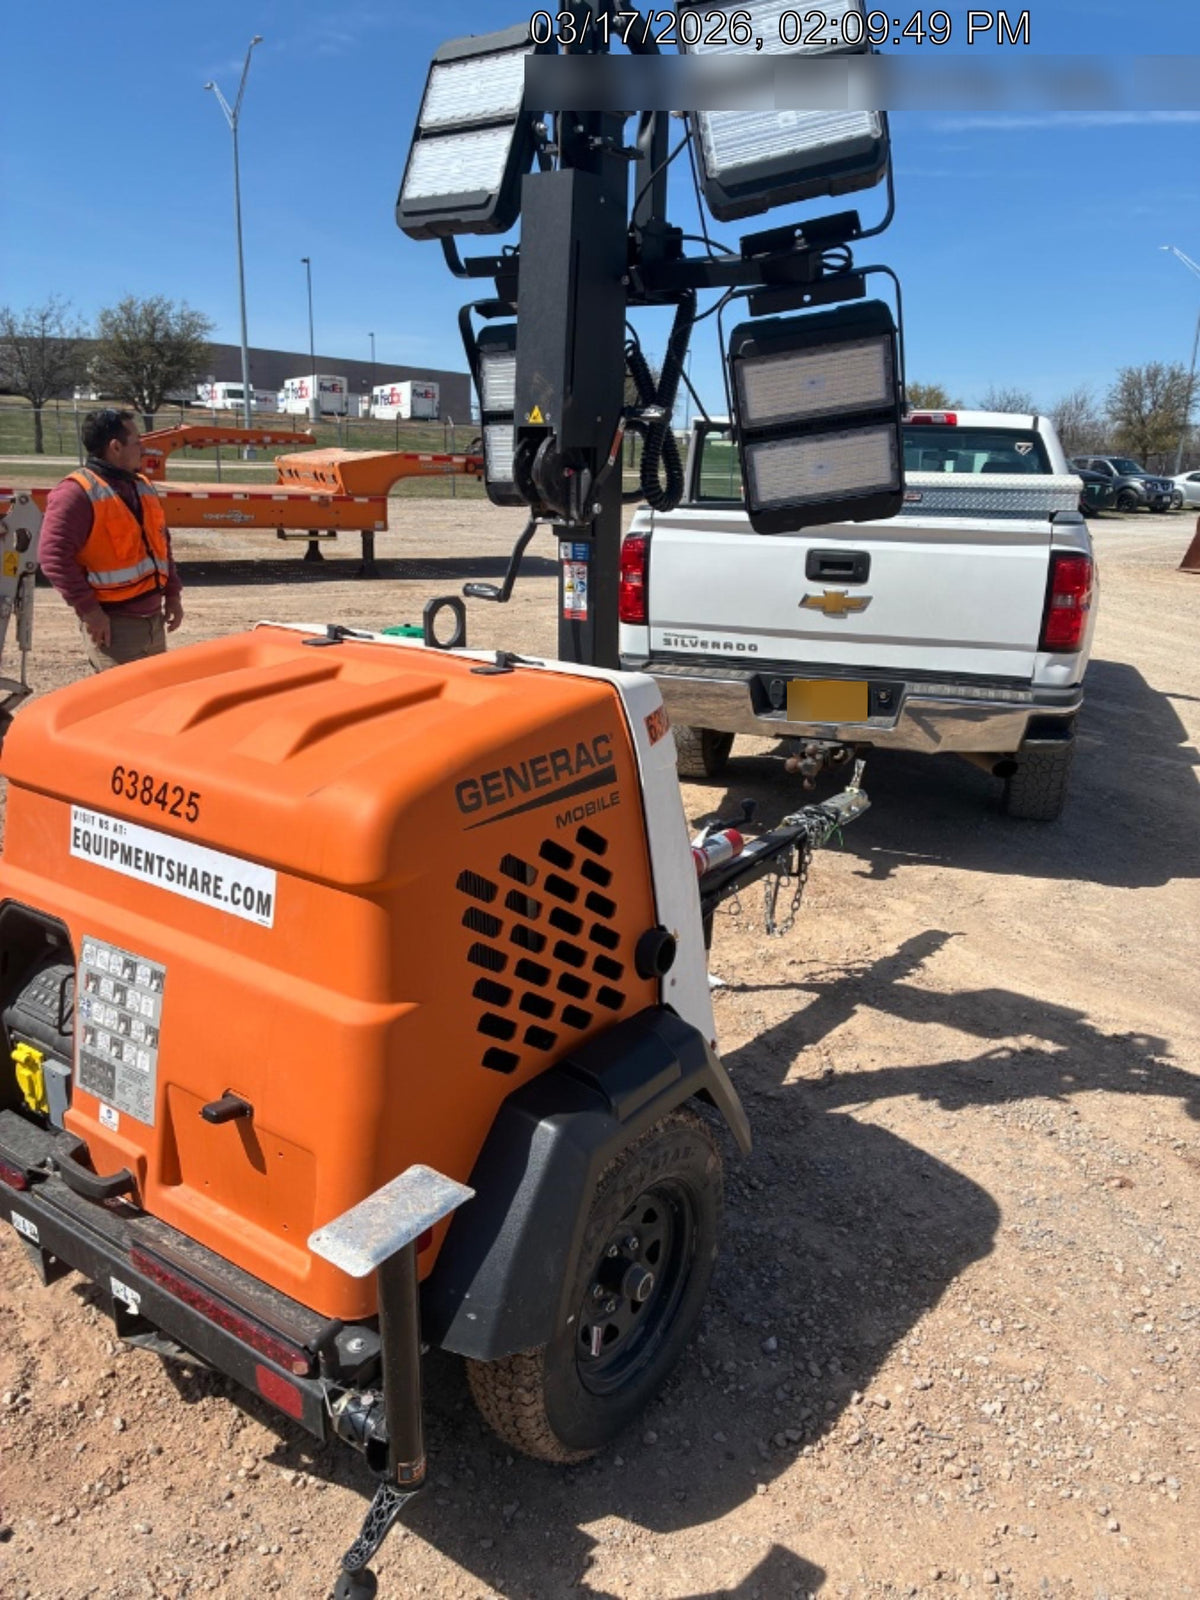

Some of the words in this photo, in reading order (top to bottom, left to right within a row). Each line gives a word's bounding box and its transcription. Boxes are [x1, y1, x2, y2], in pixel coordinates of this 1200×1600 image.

[663, 637, 758, 652] SILVERADO
[111, 766, 201, 823] 638425
[455, 734, 613, 814] GENERAC
[73, 810, 95, 826] VISIT
[99, 818, 109, 831] US
[113, 823, 127, 835] AT:
[555, 791, 621, 829] MOBILE
[73, 826, 272, 918] EQUIPMENTSHARE.COM
